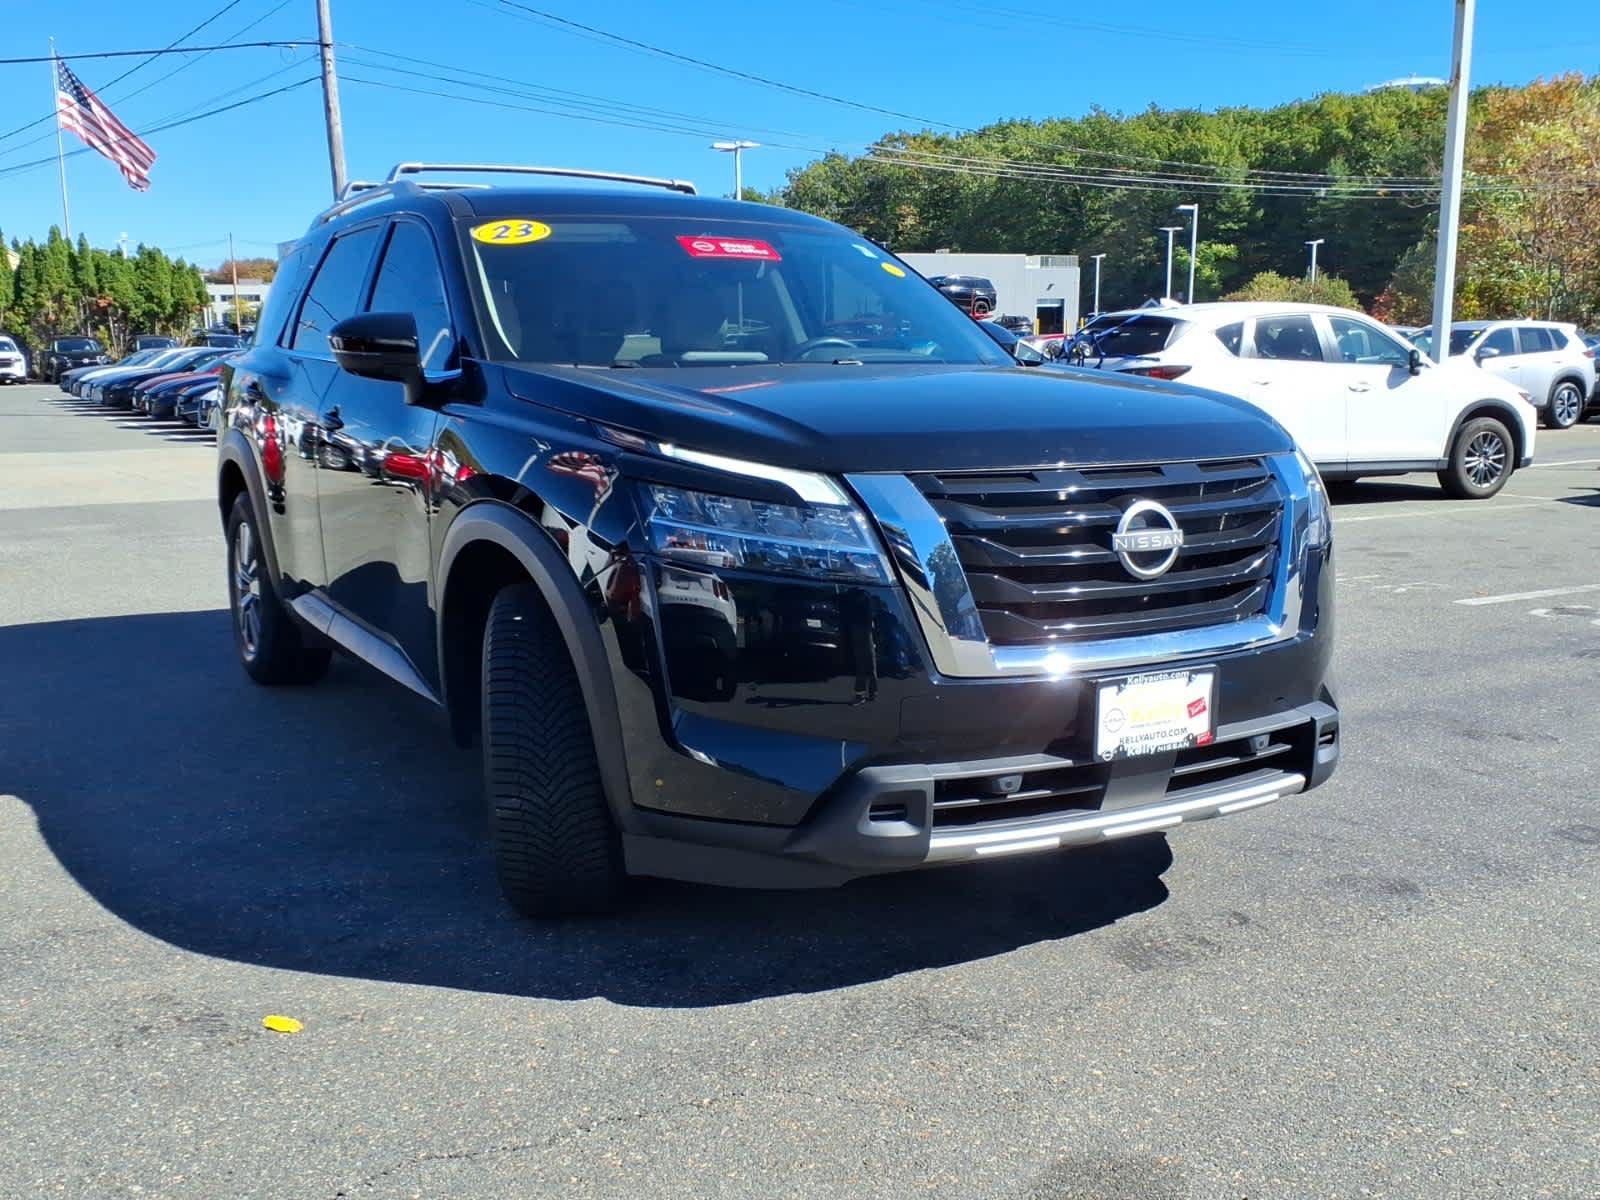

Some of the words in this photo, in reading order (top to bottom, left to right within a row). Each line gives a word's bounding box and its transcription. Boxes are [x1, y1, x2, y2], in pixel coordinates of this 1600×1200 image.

[490, 223, 533, 240] 23
[1115, 534, 1183, 548] NISSAN
[1119, 727, 1188, 744] KELLYAUTO.COM
